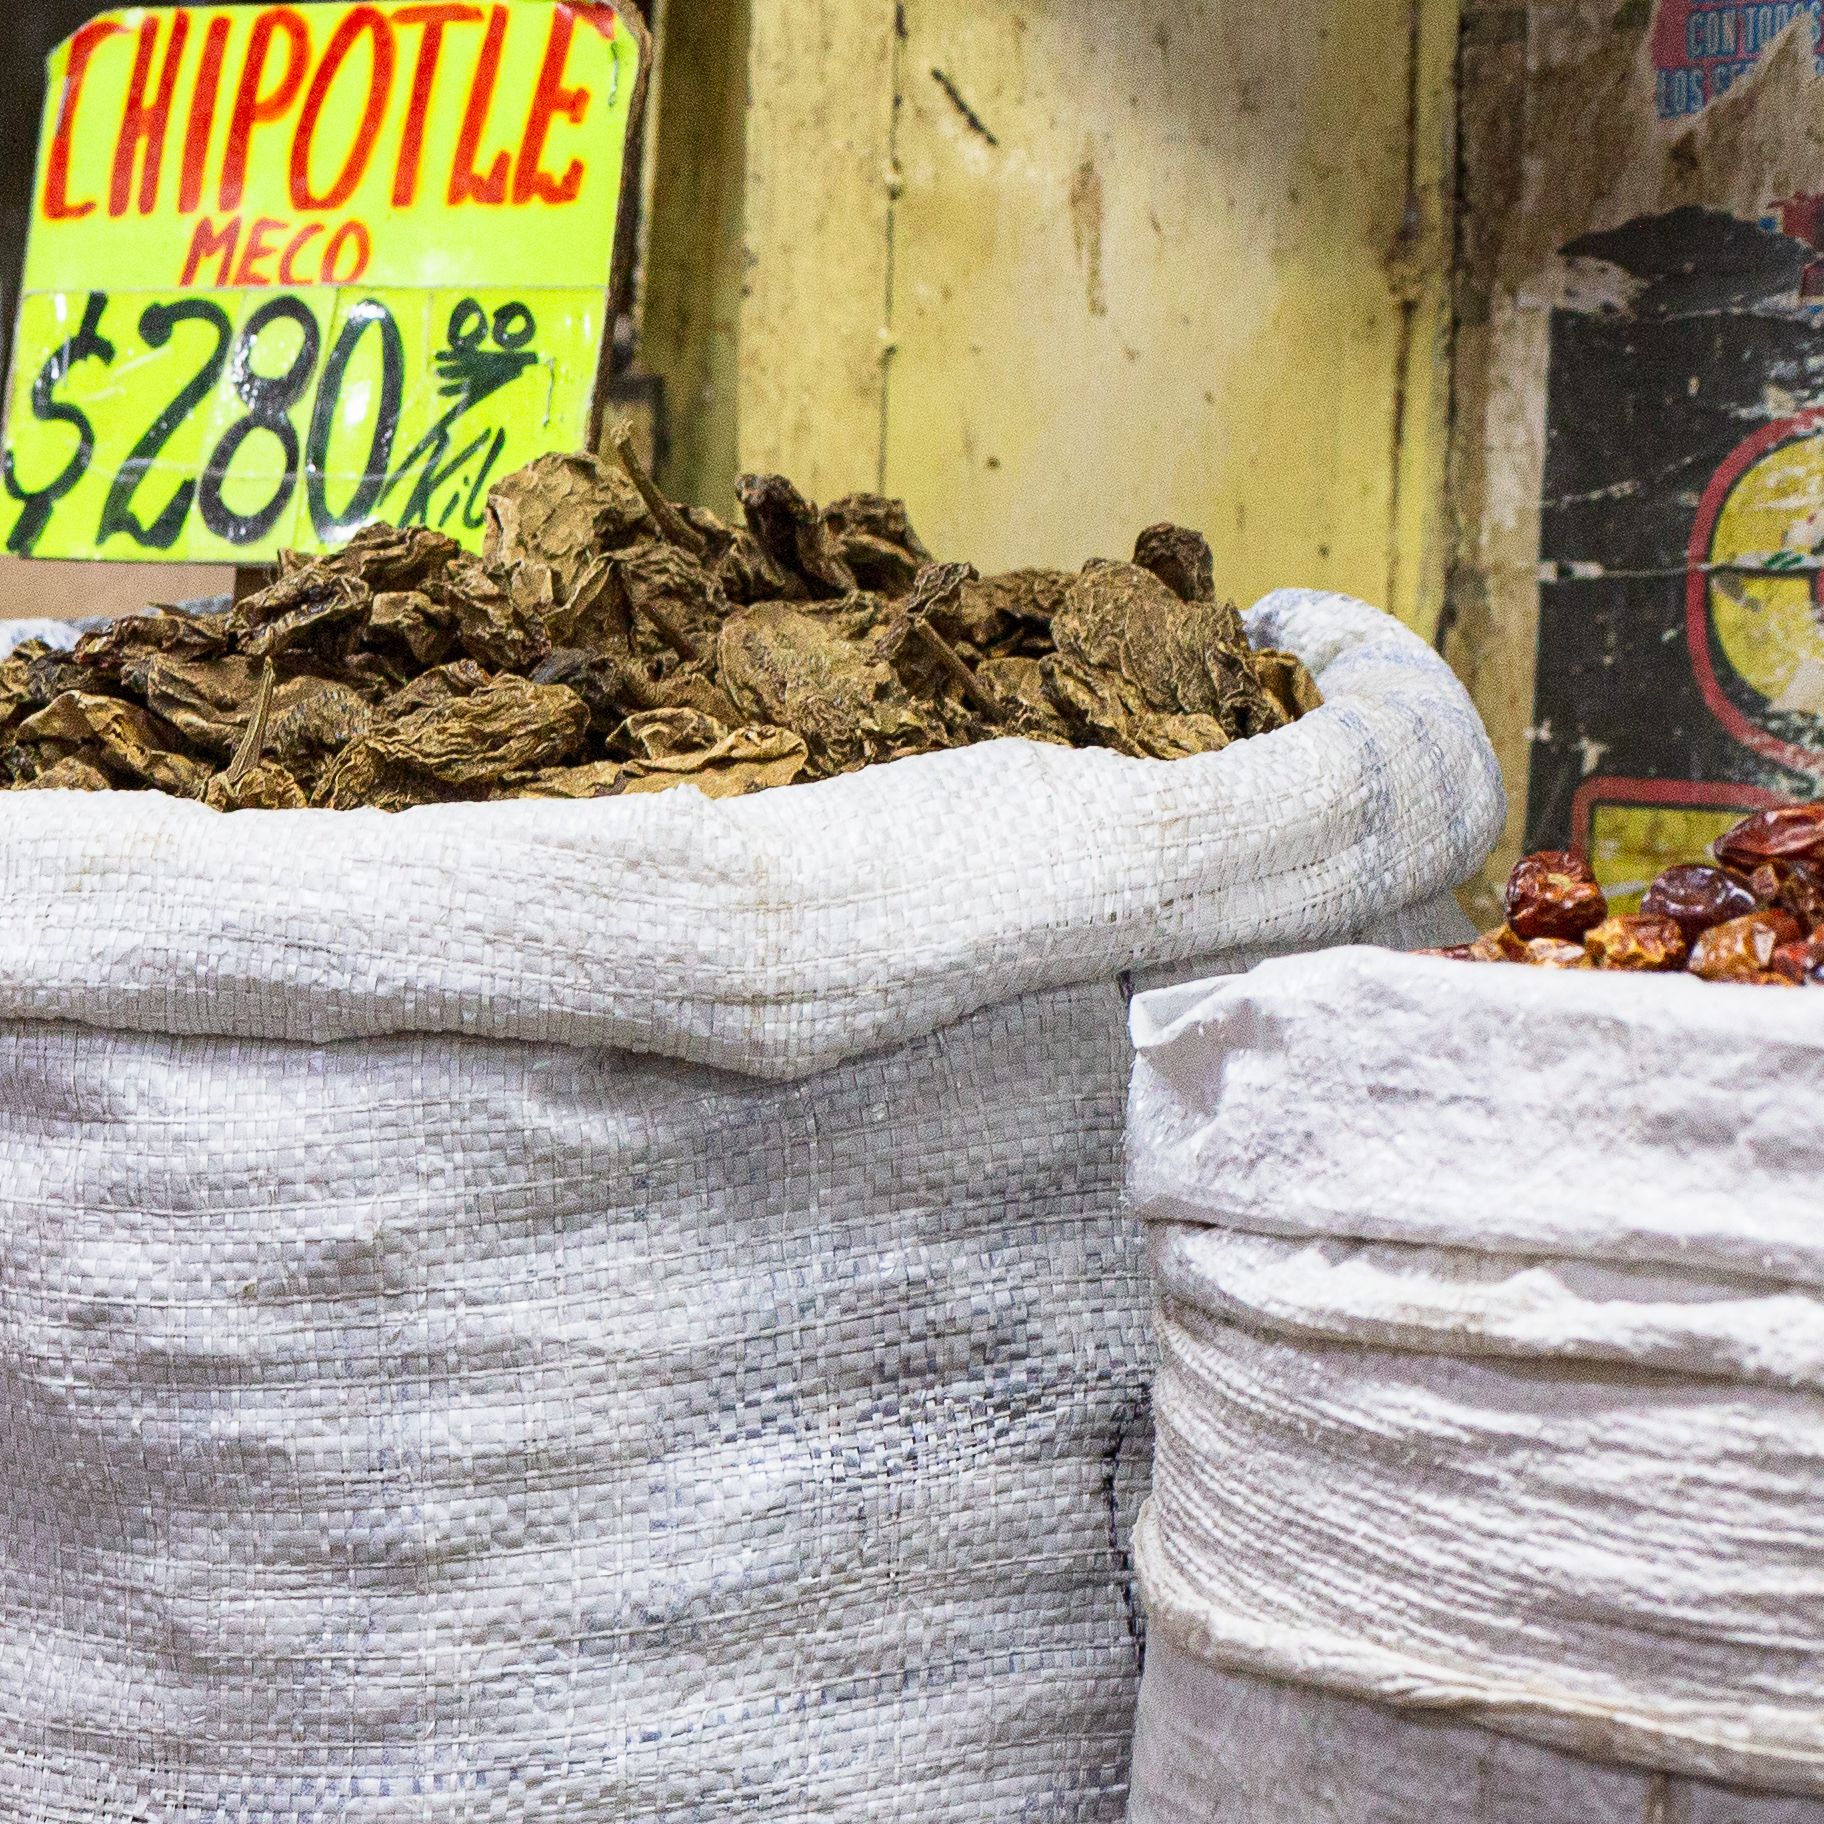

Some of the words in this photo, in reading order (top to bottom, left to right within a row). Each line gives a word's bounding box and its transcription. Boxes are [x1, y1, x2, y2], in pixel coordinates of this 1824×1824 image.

[43, 2, 614, 220] CHIPOTLE
[180, 216, 373, 286] MECO
[2, 291, 405, 557] $280
